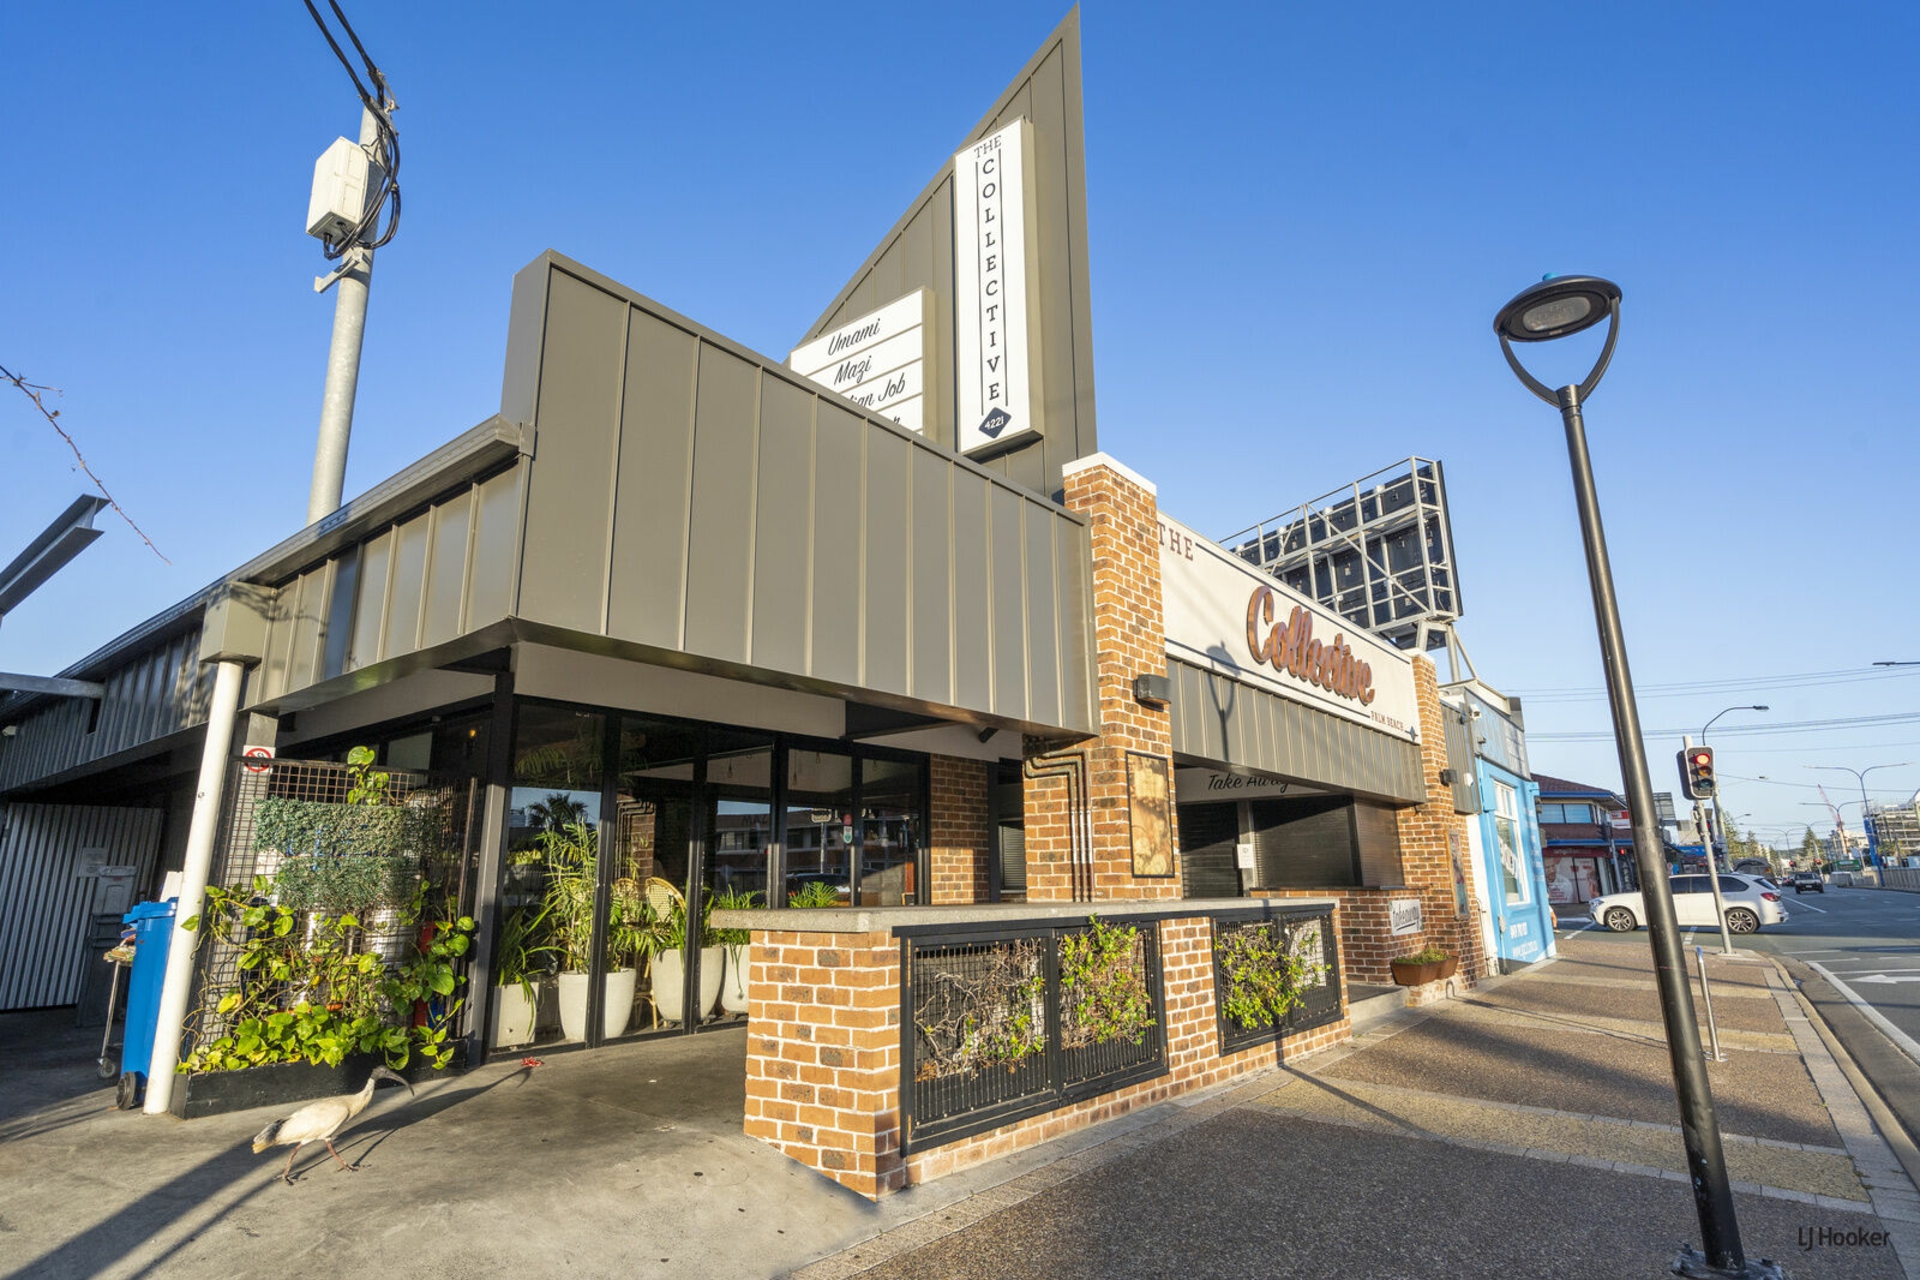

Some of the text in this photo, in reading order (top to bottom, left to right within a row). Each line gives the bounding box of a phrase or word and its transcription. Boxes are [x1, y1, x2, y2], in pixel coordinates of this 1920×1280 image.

[974, 135, 1002, 158] THE
[982, 158, 1000, 401] COLLECTIVE
[828, 317, 881, 356] Umami
[834, 355, 872, 385] Mazi
[878, 372, 906, 402] Job
[984, 415, 1004, 430] 4221
[1157, 520, 1194, 562] THE
[1246, 585, 1376, 706] Collective
[1208, 773, 1244, 791] Take
